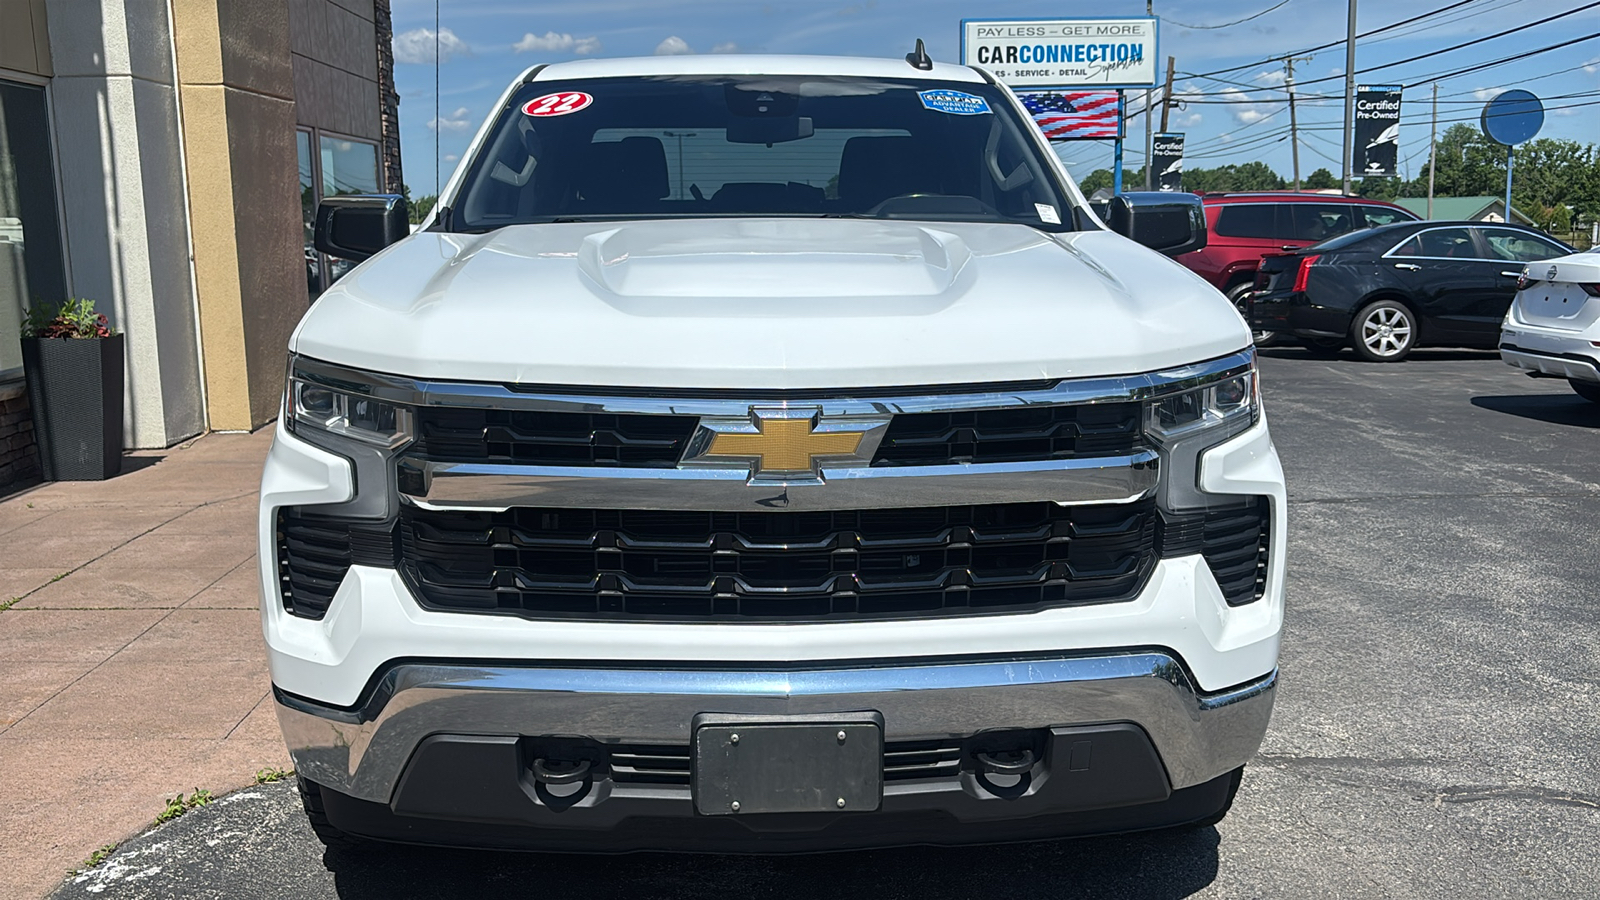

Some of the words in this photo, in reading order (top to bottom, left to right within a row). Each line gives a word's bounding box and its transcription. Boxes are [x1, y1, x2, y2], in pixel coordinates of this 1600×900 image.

[977, 27, 1005, 37] PAY
[1008, 27, 1046, 36] LESS
[1062, 26, 1092, 36] GET
[1096, 25, 1146, 35] MORE.
[1015, 69, 1050, 77] SERVICE
[533, 93, 581, 114] 22
[932, 101, 980, 109] ADVANTAGE
[1357, 99, 1400, 110] Certified
[1356, 111, 1399, 119] Pre-Owned
[1154, 142, 1183, 150] Certified
